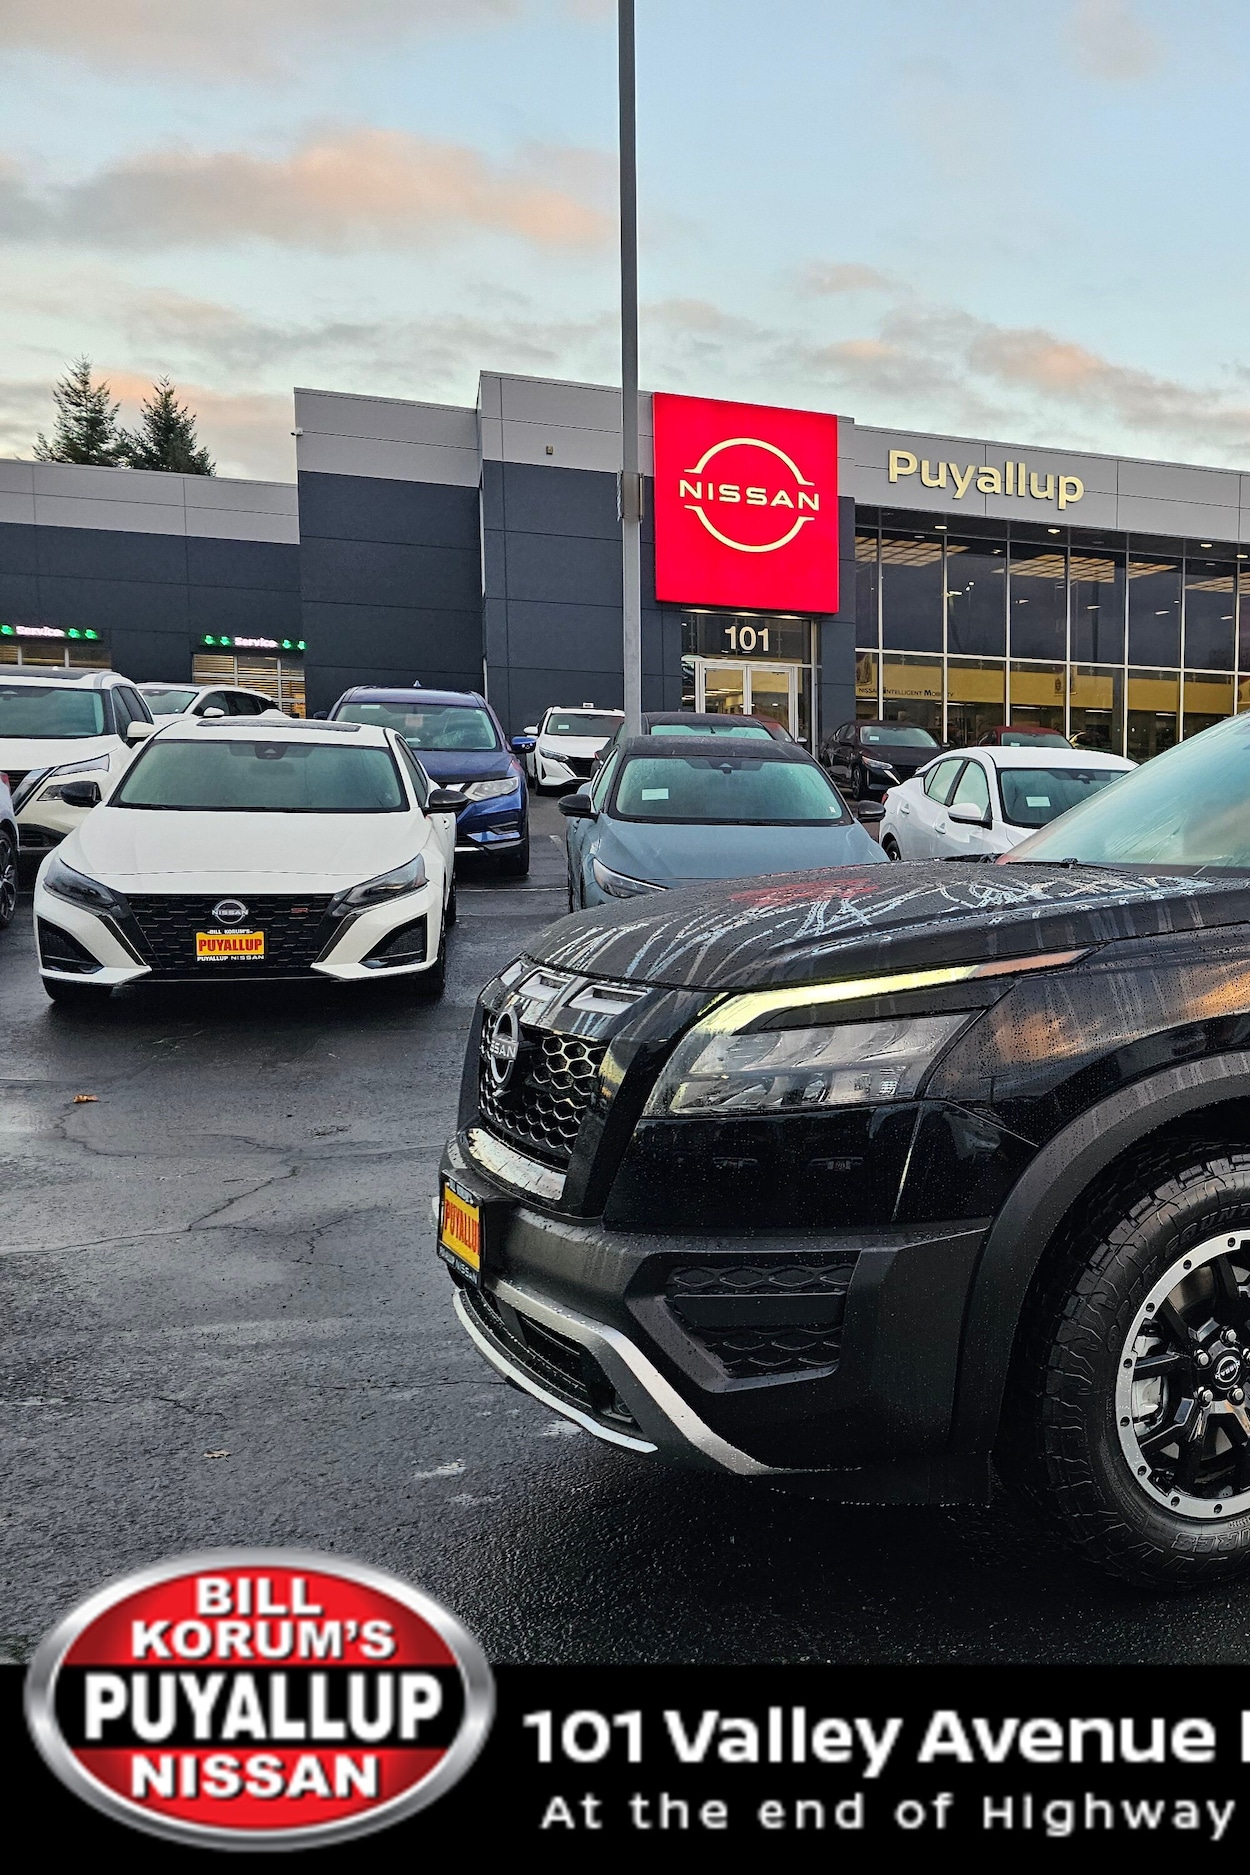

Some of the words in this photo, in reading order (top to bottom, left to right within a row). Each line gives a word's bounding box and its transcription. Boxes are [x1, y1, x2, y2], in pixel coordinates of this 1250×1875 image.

[888, 449, 1085, 511] Puyallup
[679, 479, 820, 511] NISSAN
[16, 625, 66, 637] Service
[234, 636, 279, 648] Service
[724, 626, 769, 653] 101
[211, 908, 249, 916] NISSAN
[198, 938, 263, 952] PUYALLUP
[489, 1040, 517, 1058] SSAN
